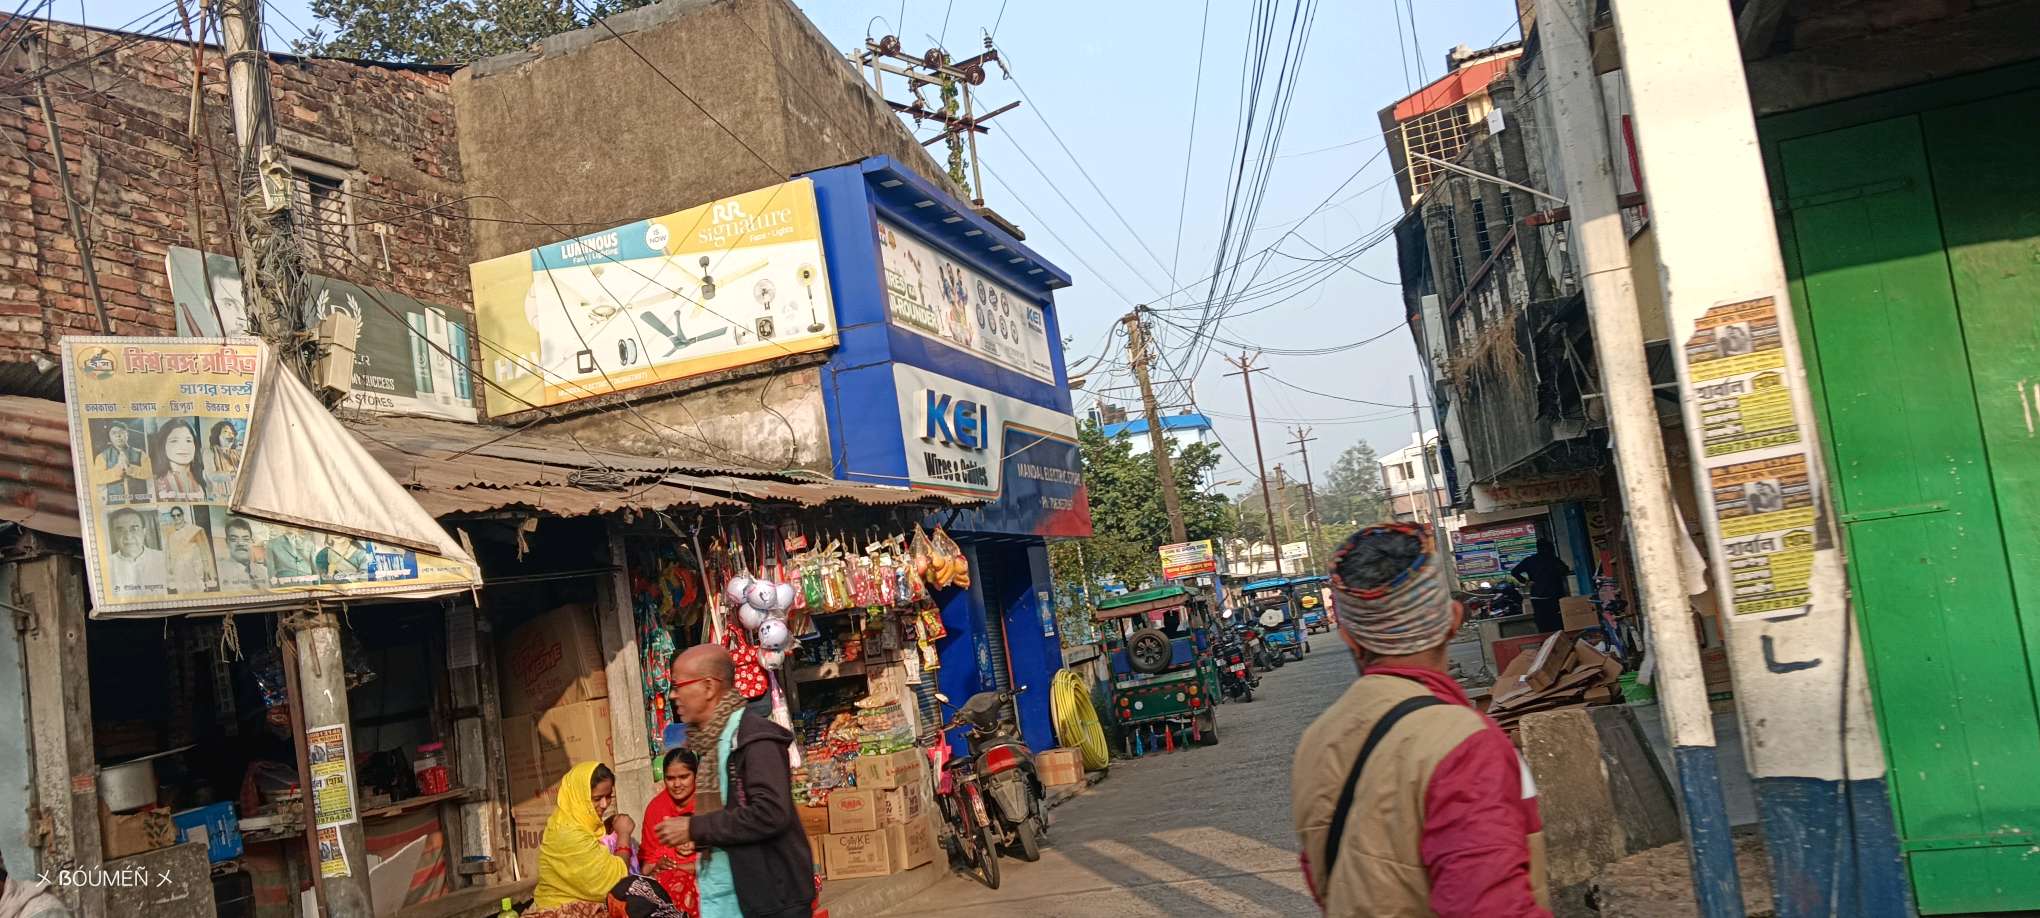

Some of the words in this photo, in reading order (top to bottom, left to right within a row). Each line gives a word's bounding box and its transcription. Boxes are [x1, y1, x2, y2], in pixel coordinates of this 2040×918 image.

[699, 207, 792, 248] signature
[561, 231, 618, 259] LUMINOUS
[1026, 306, 1042, 326] KEI
[122, 346, 163, 374] বিশ্ব
[180, 382, 218, 397] সাগর
[362, 375, 395, 391] SUCCESS
[355, 393, 395, 408] STORES
[918, 387, 989, 451] KEI
[924, 452, 952, 480] Wires
[960, 458, 989, 487] Cables
